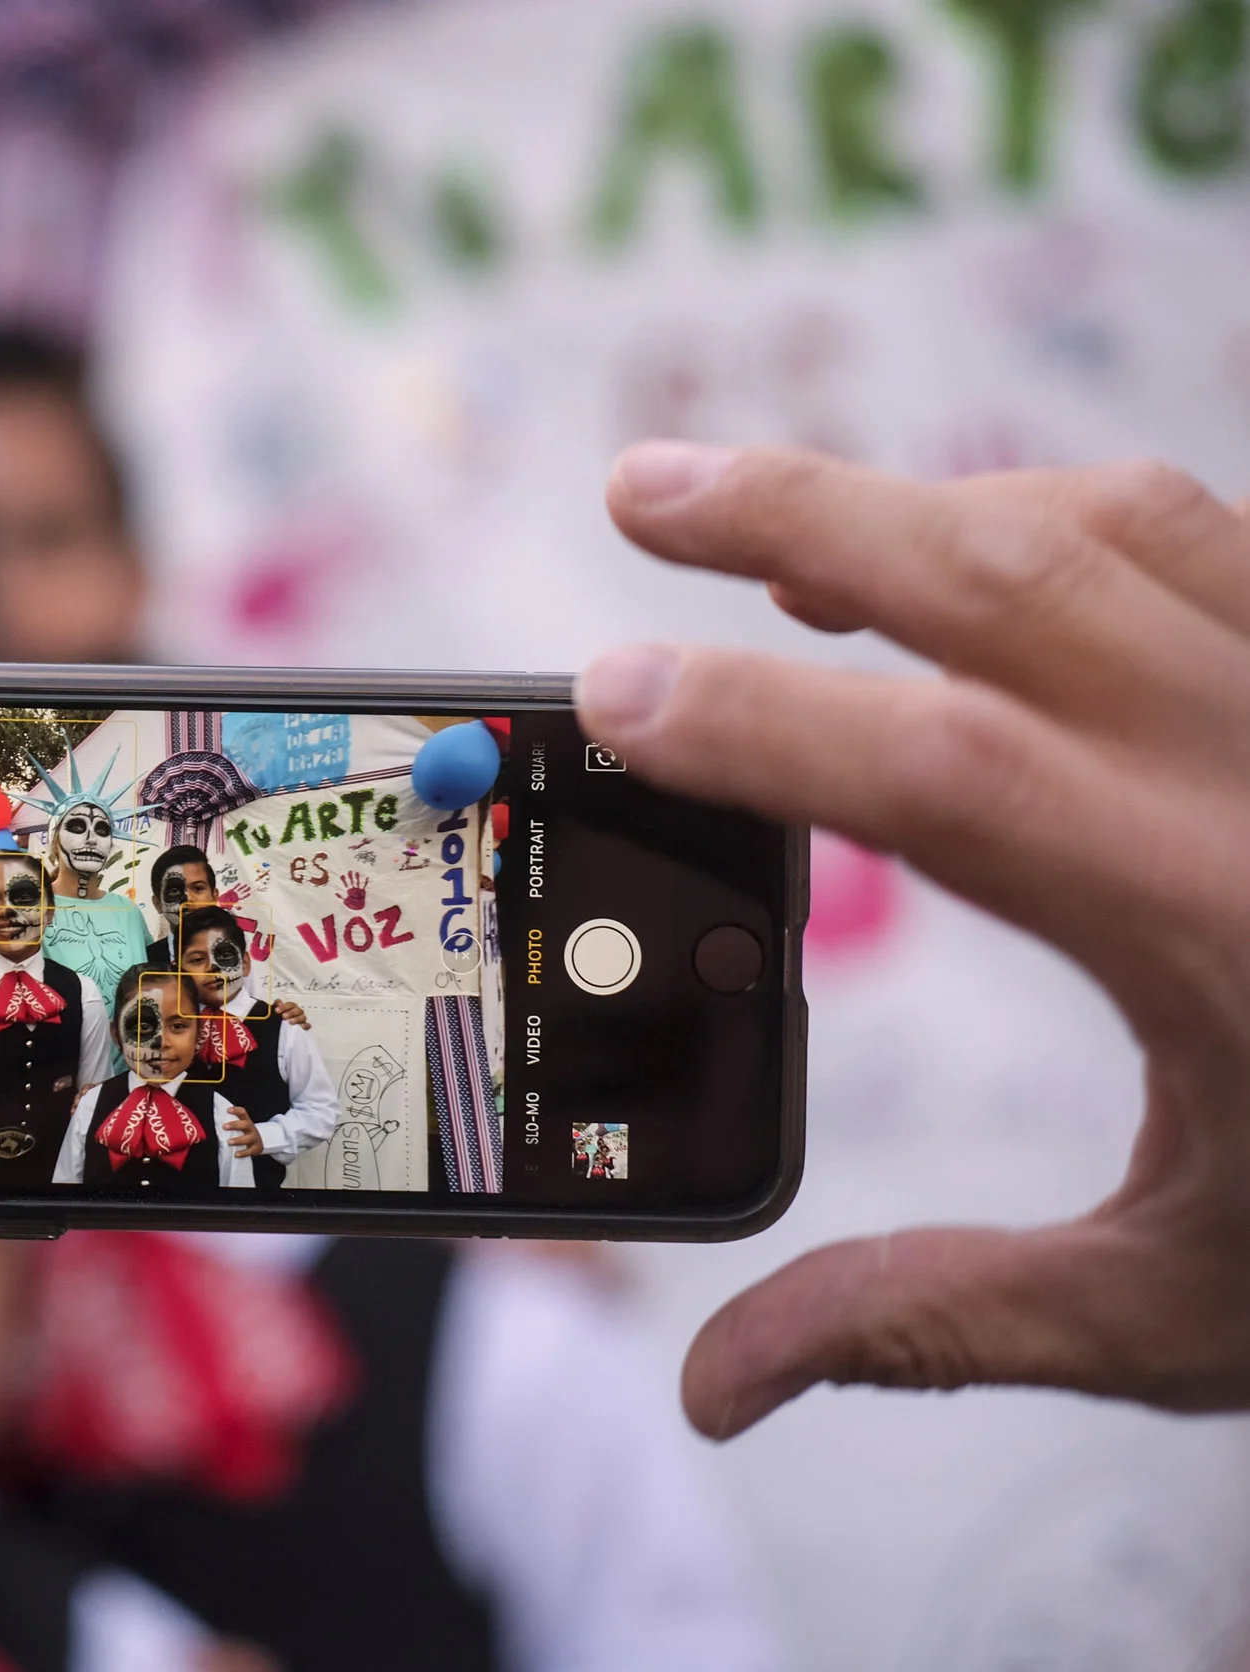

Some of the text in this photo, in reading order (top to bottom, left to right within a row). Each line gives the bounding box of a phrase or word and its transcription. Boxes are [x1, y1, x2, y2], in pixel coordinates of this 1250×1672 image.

[530, 740, 547, 792] SQUARE
[529, 819, 545, 898] PORTRAIT
[452, 948, 471, 961] 1x
[527, 929, 544, 985] PHOTO
[526, 1014, 542, 1066] VIDEO
[525, 1091, 540, 1146] SLO-MO
